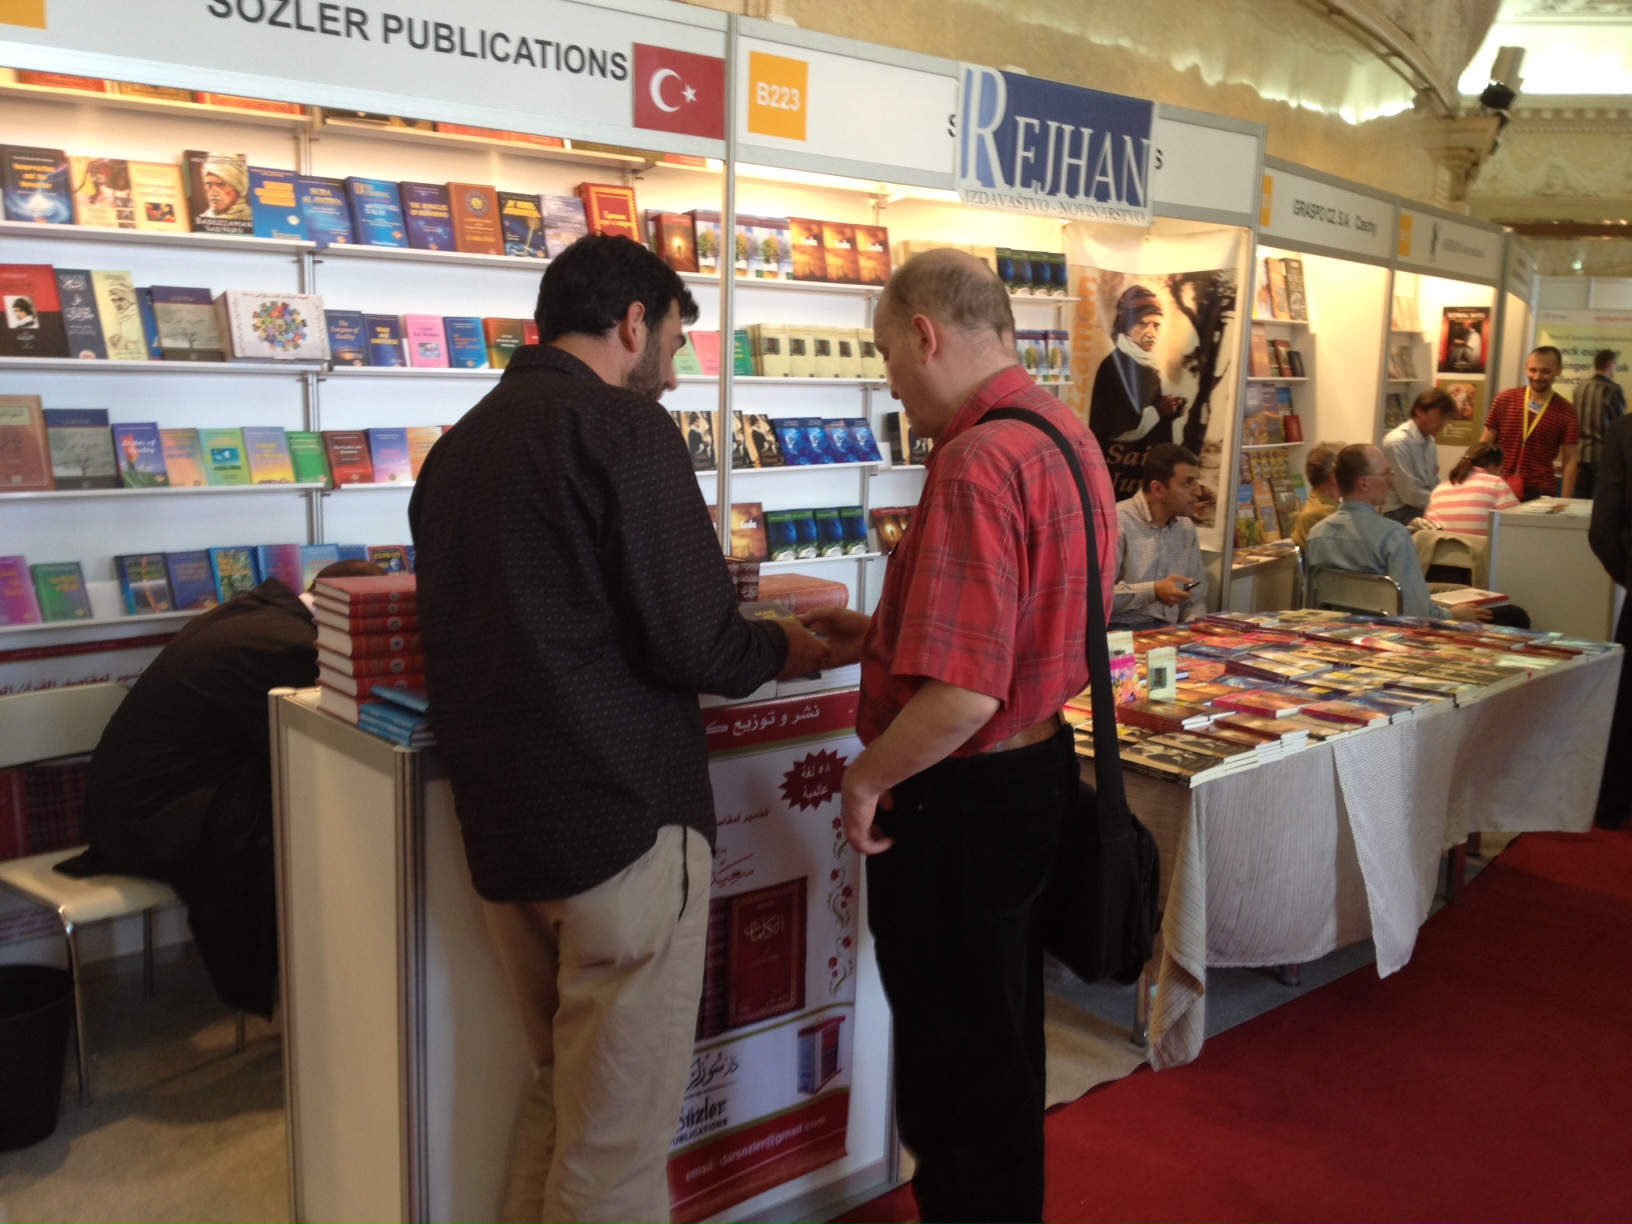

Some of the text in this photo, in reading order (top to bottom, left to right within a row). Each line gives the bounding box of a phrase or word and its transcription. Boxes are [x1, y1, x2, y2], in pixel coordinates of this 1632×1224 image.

[381, 13, 629, 81] PUBLICATIONS
[757, 81, 801, 112] B223
[963, 65, 1152, 209] REJHAN
[732, 711, 776, 737] توزيع
[777, 714, 788, 727] و
[791, 704, 820, 726] نشر
[671, 1116, 728, 1146] UBLICATIONS
